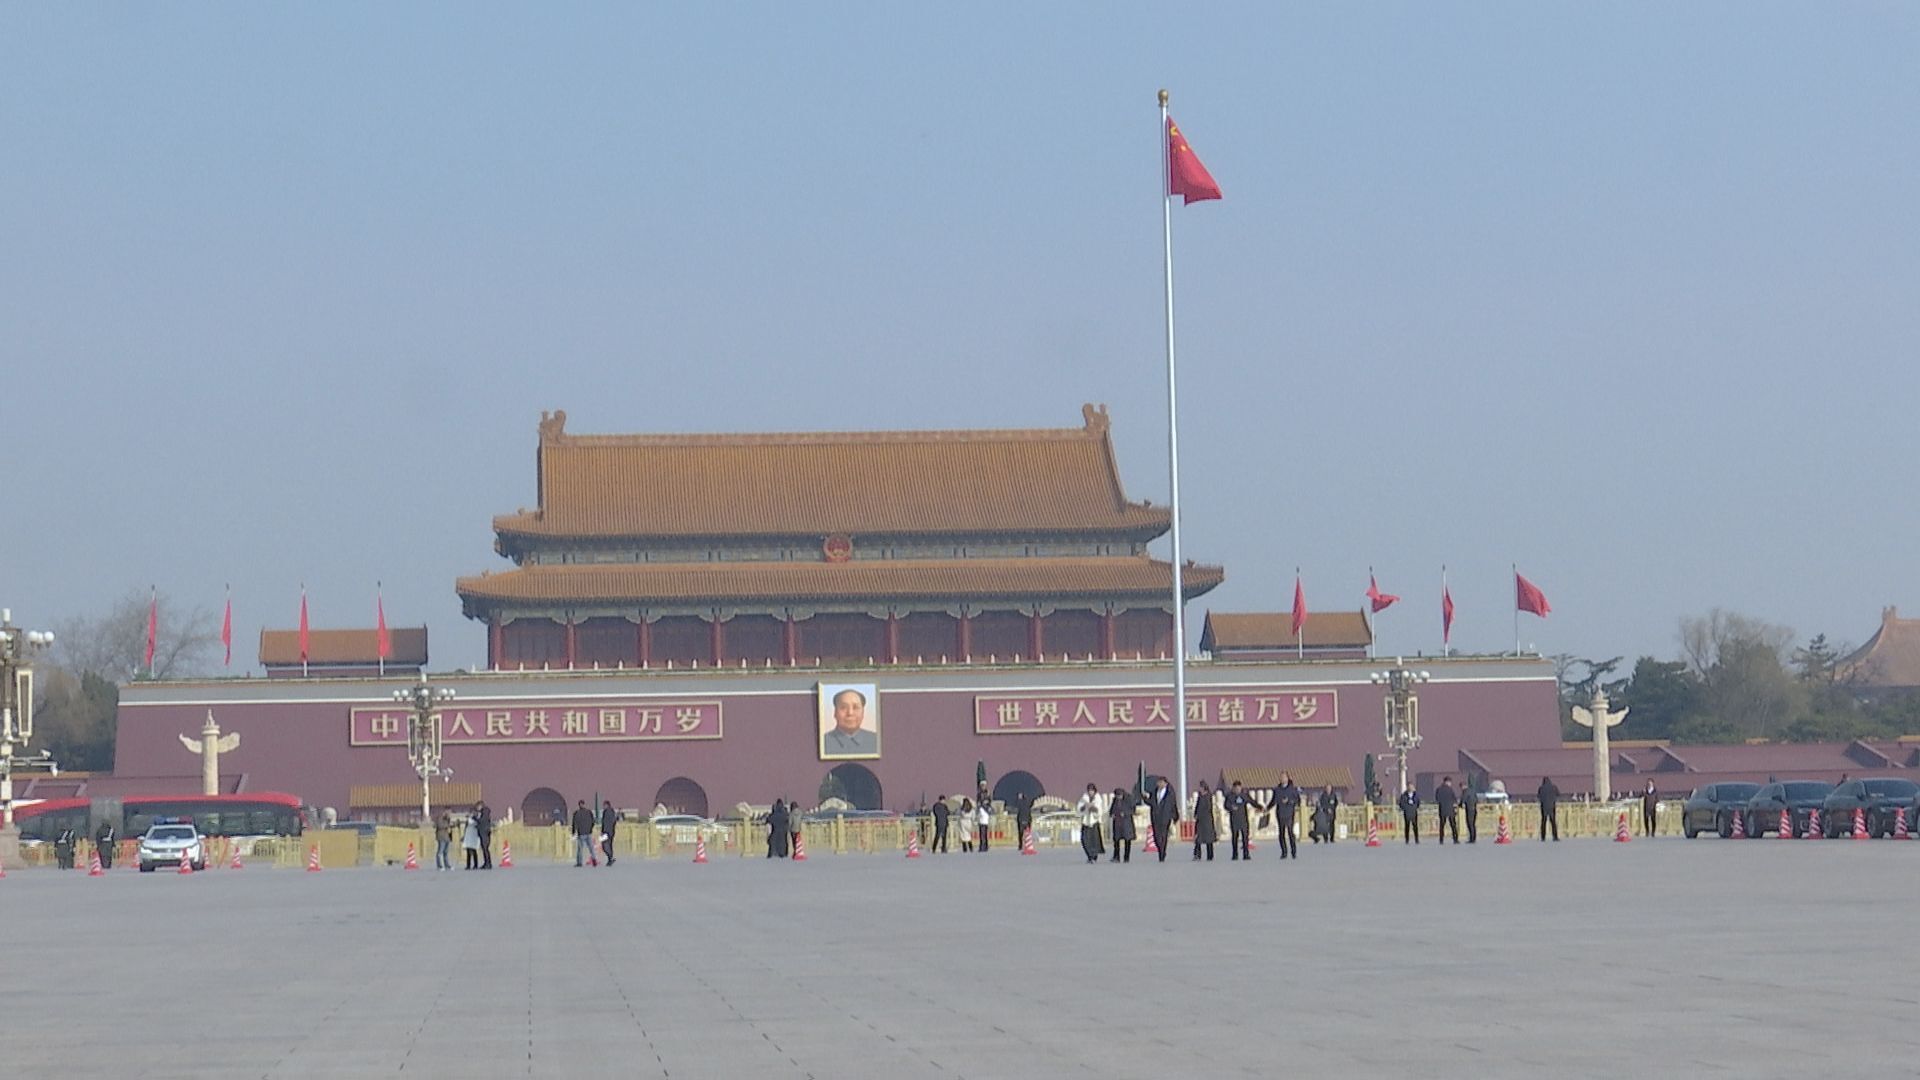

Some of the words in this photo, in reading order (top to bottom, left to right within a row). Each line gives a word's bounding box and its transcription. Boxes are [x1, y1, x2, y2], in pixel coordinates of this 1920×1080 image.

[371, 708, 703, 738] 中人民共和国万岁
[997, 696, 1318, 727] 世界人民大团结万岁
